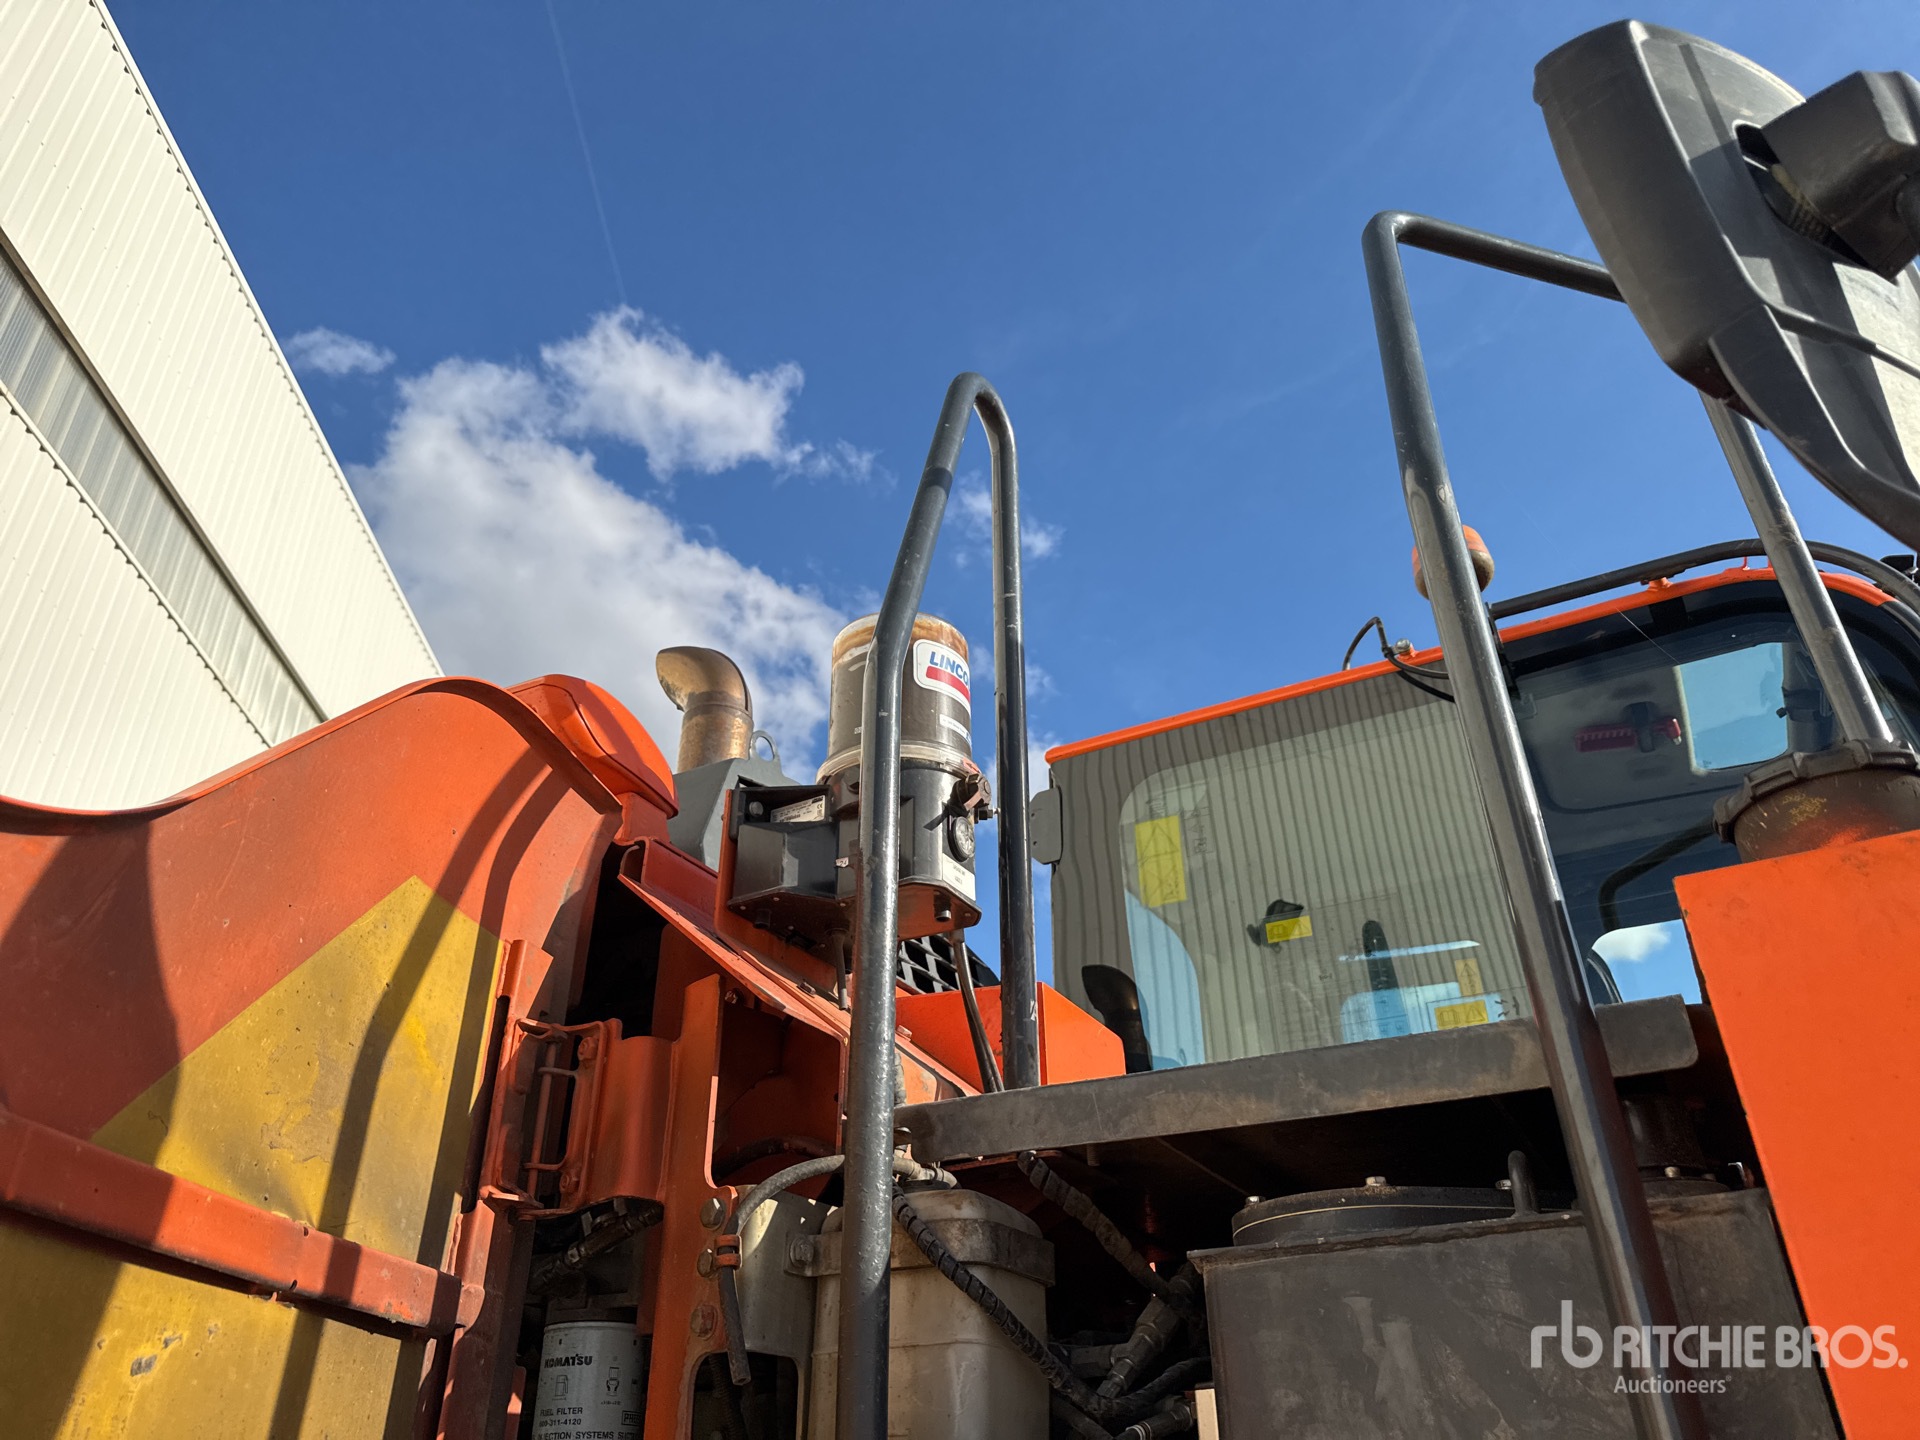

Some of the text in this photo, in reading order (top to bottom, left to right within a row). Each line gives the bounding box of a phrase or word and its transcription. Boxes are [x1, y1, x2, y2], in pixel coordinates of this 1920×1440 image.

[544, 1354, 593, 1369] KOMATSU
[556, 1407, 584, 1415] FILTER
[575, 1431, 614, 1440] SYSTEMS
